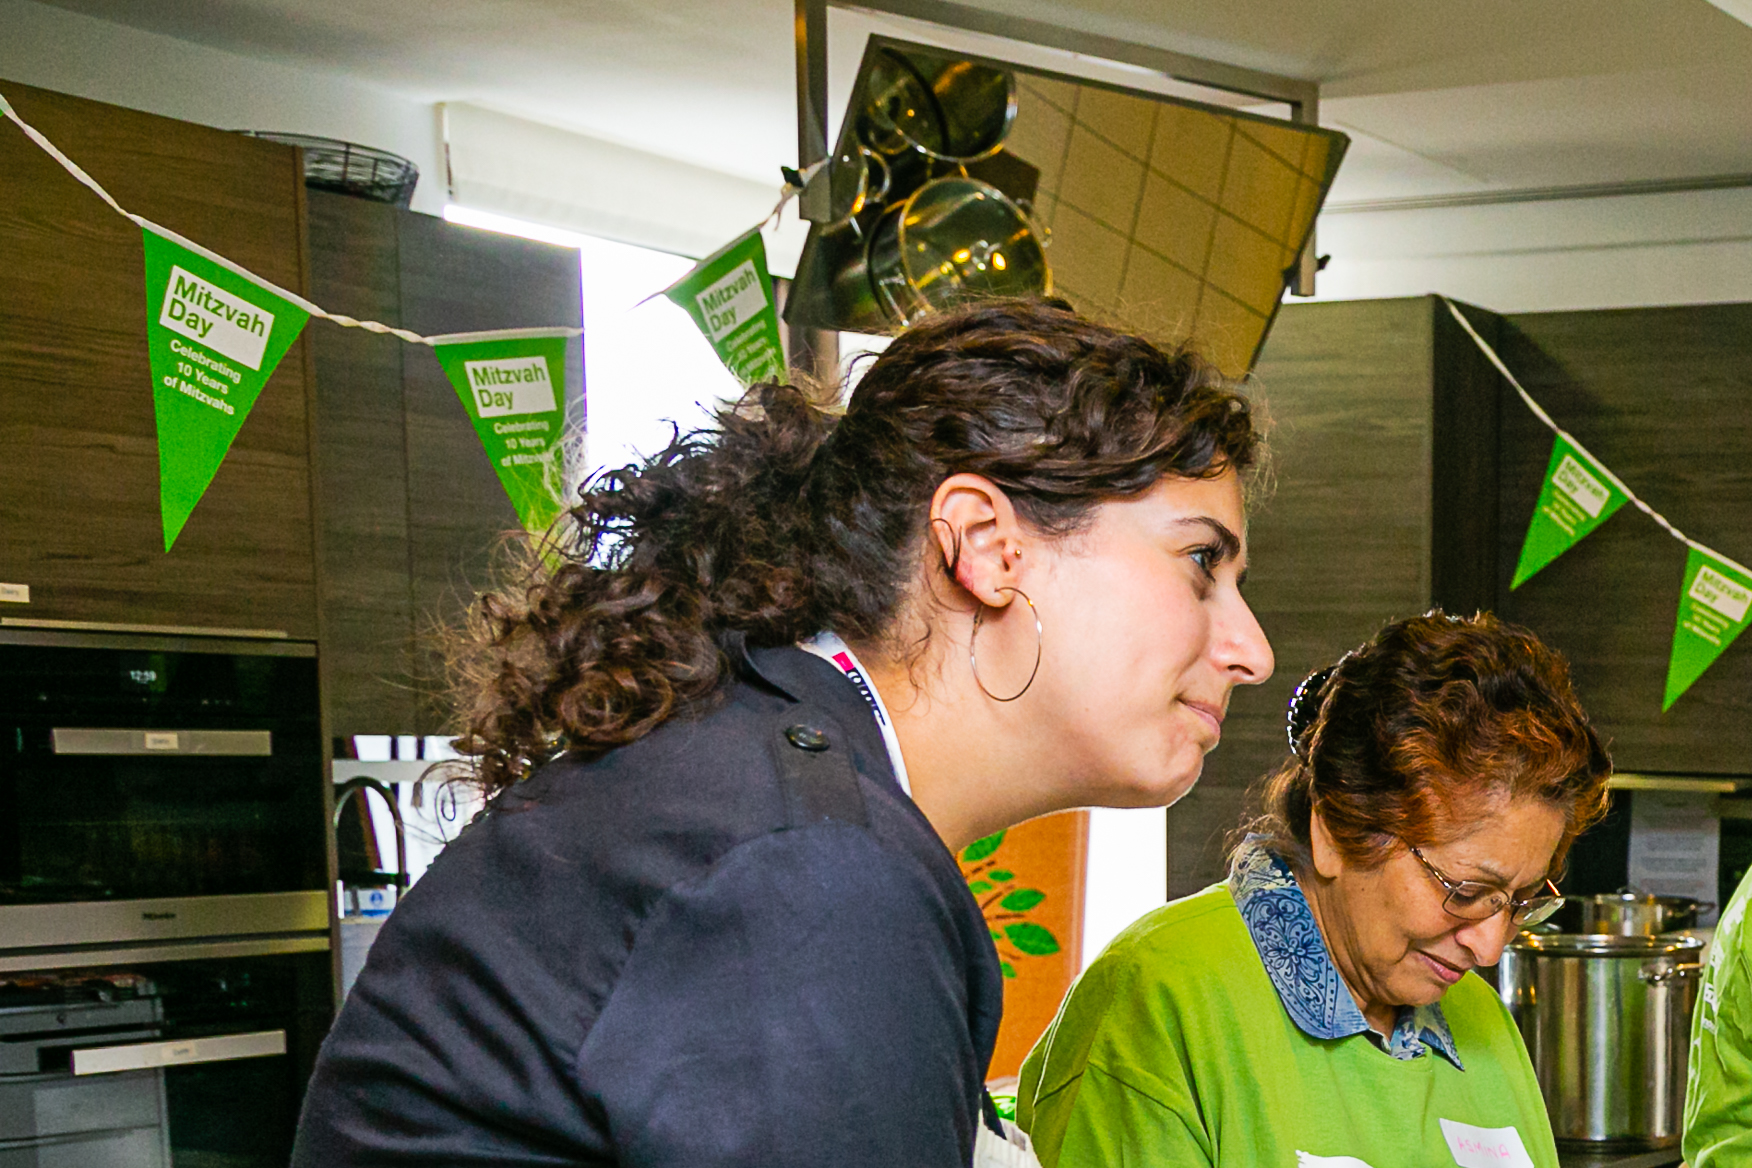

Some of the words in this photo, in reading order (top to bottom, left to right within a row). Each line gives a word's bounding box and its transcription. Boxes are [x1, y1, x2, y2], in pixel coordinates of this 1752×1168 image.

[173, 275, 266, 337] Mitzvah
[702, 269, 756, 314] Mitzvah
[168, 297, 214, 338] Day
[710, 307, 737, 332] Day
[170, 339, 242, 384] Celebrating
[178, 361, 192, 377] 10
[195, 368, 229, 395] Years
[472, 363, 546, 387] Mitzvah
[163, 375, 179, 389] of
[179, 380, 235, 415] Mitzvahs
[478, 389, 514, 410] Day
[1694, 582, 1717, 604] Day
[1702, 571, 1748, 604] Mitzvah
